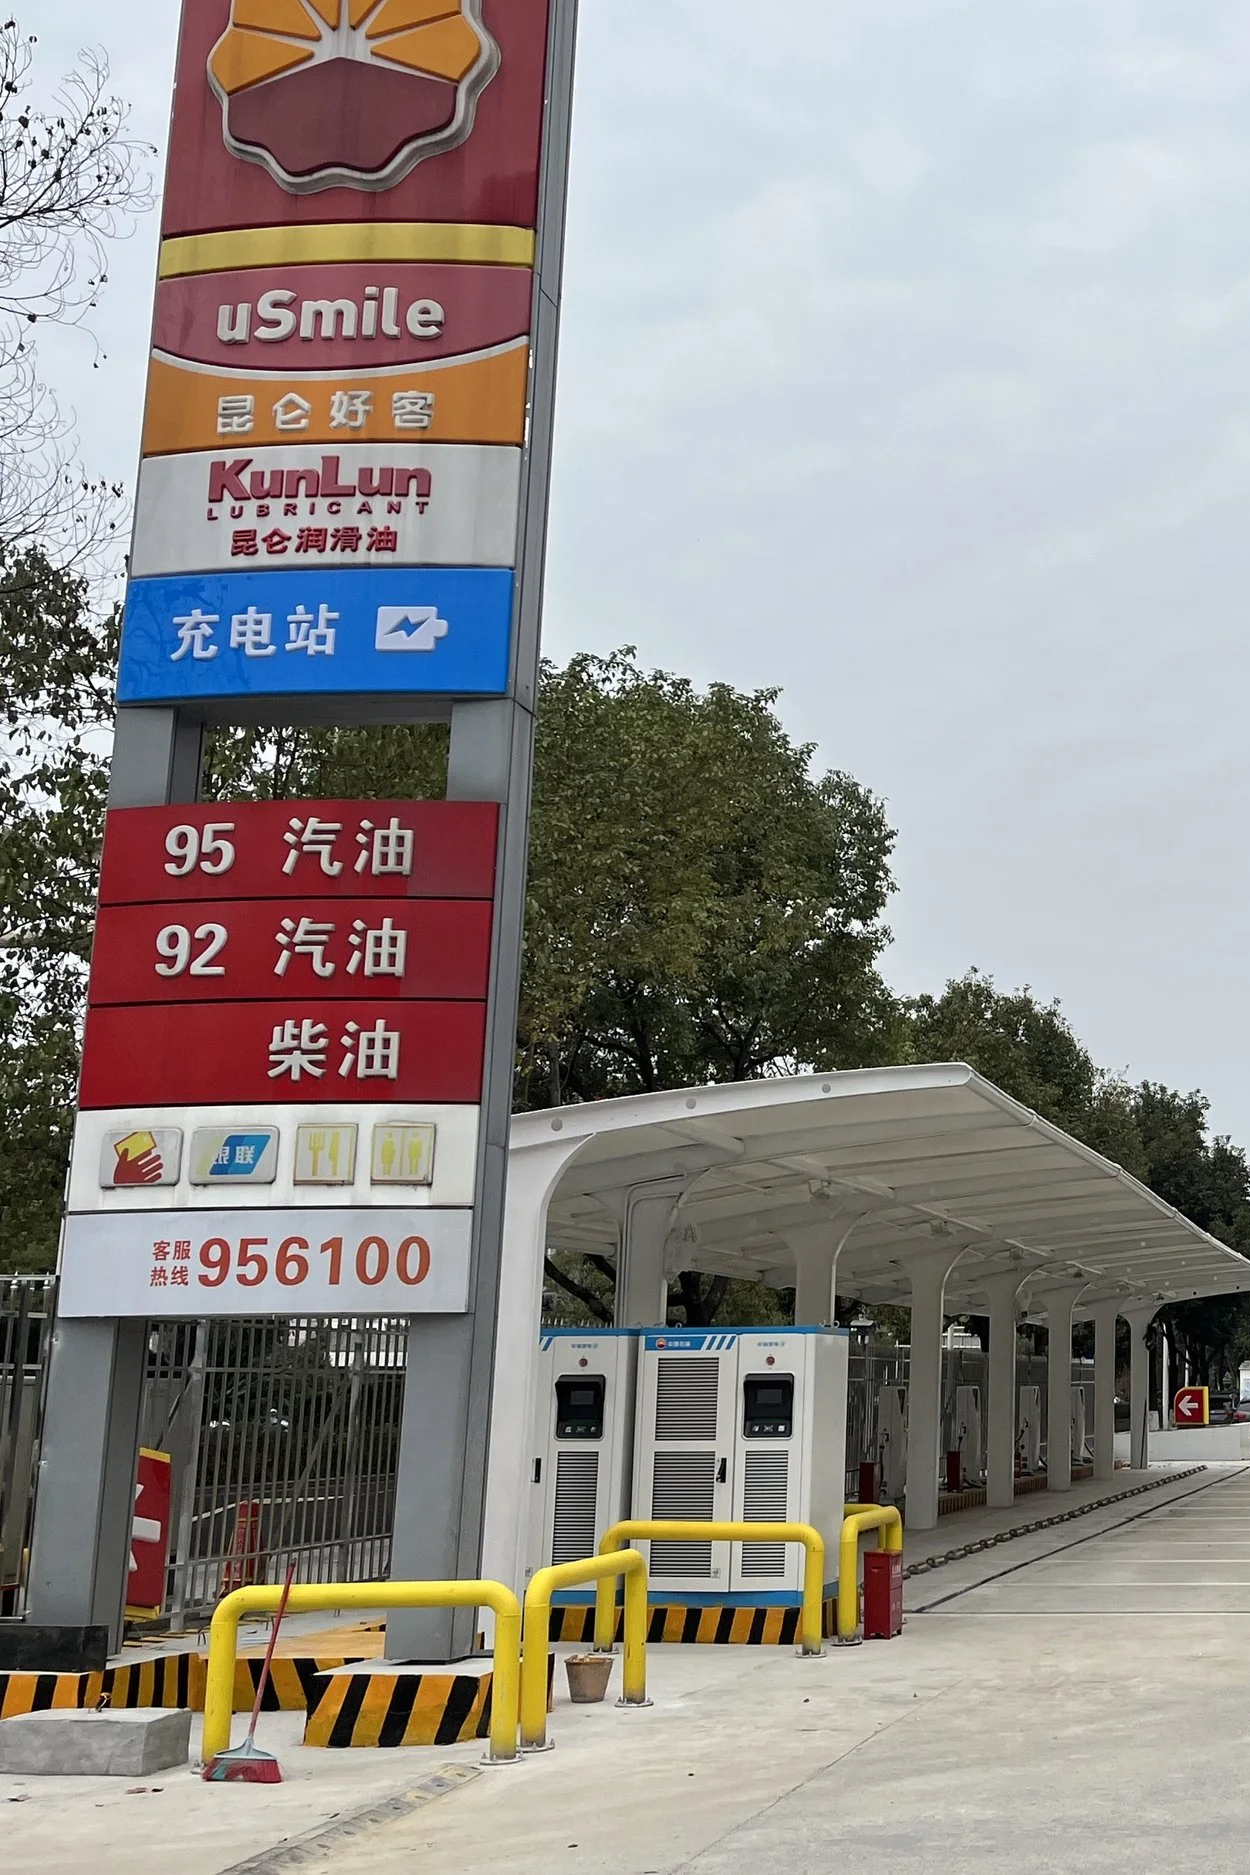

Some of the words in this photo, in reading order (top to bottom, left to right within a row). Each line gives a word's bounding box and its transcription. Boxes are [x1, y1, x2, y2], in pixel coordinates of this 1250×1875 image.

[216, 286, 445, 345] uSmile
[216, 390, 435, 436] 昆仑好客
[208, 455, 432, 503] KunLun
[207, 501, 429, 521] LUBRICANT
[231, 526, 398, 556] 昆仑润滑油
[170, 603, 340, 662] 充电站
[164, 823, 235, 877] 95
[281, 817, 415, 877] 汽油
[154, 923, 228, 977] 92
[273, 917, 408, 978] 汽油
[267, 1019, 400, 1081] 柴油
[152, 1240, 191, 1262] 客服
[198, 1235, 431, 1288] 956100
[149, 1266, 190, 1287] 热线
